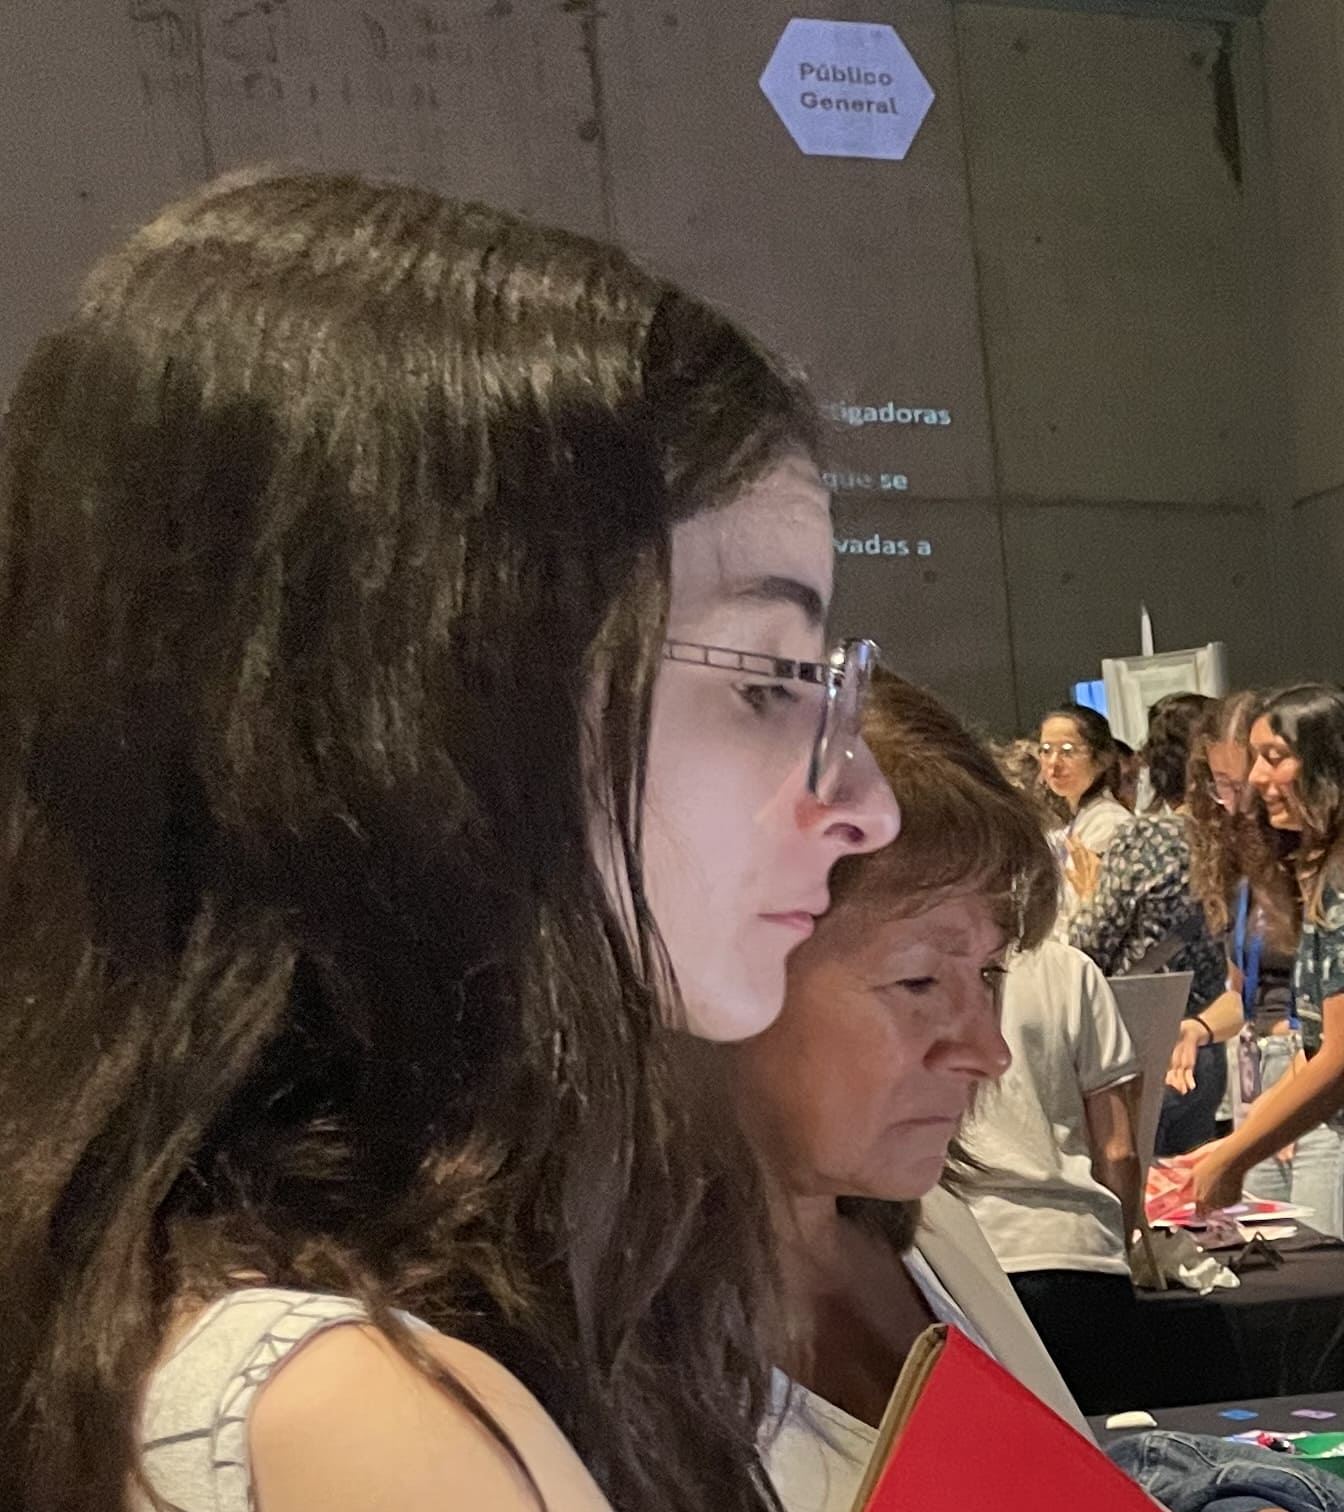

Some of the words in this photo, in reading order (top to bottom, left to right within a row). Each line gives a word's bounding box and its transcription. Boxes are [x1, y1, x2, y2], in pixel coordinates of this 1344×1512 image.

[800, 62, 893, 86] Público
[800, 91, 898, 115] General
[880, 474, 908, 490] se
[917, 541, 932, 556] a
